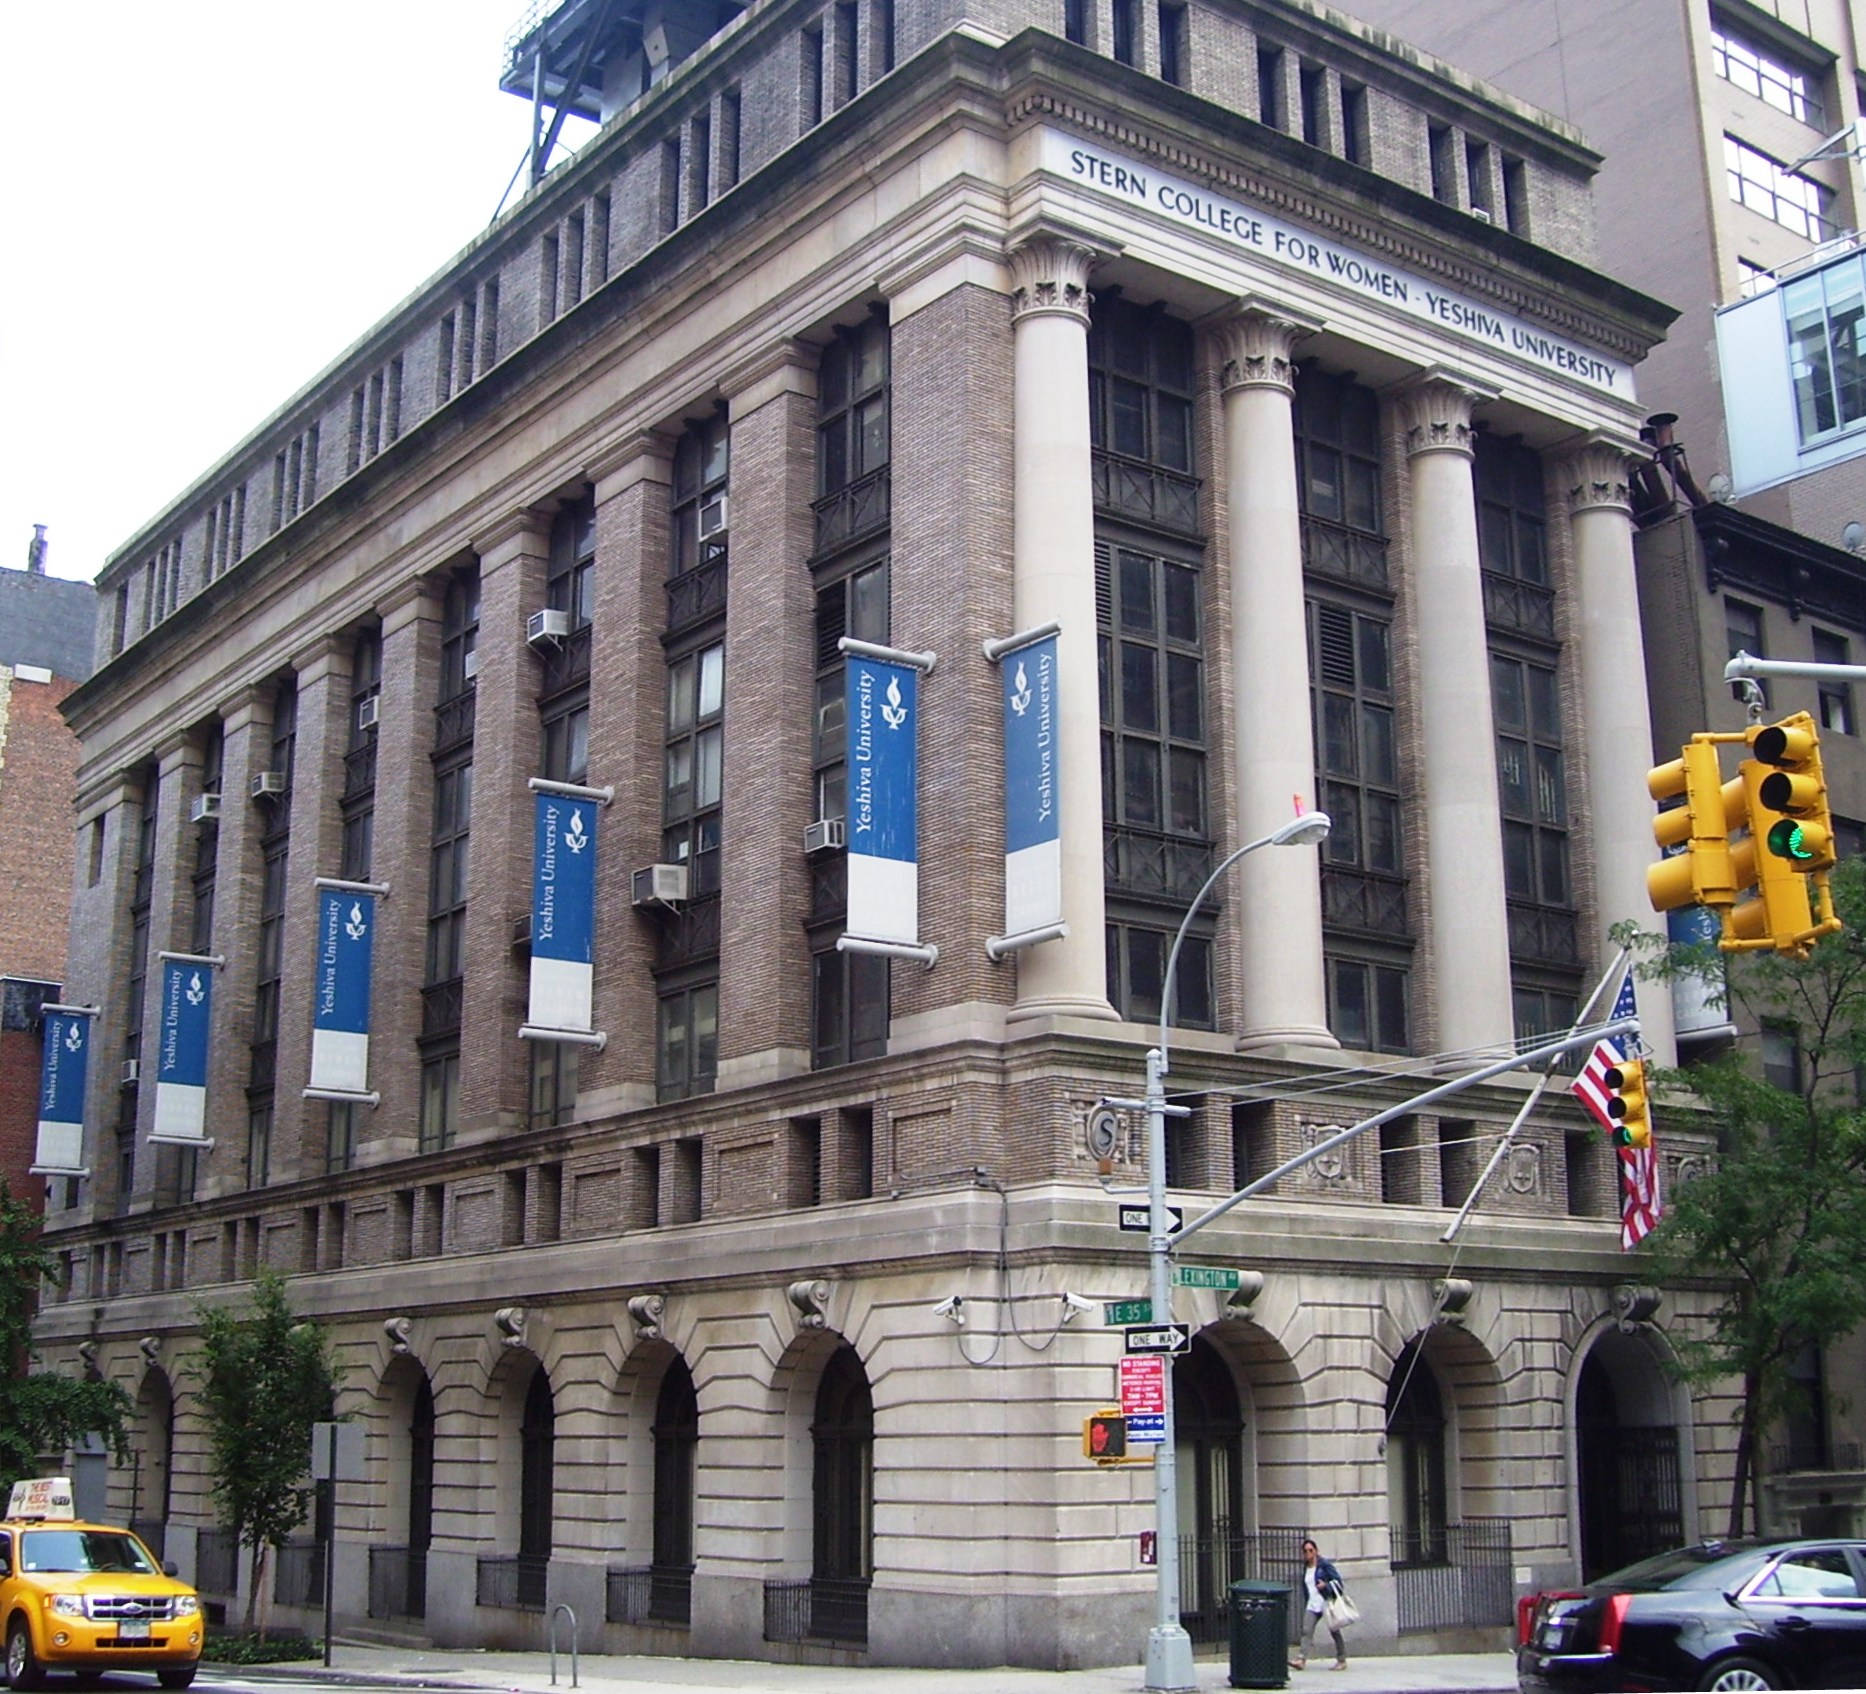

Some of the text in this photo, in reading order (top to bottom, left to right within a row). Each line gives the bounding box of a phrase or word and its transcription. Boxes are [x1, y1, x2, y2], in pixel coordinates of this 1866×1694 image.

[1071, 150, 1147, 198] STERN
[1158, 186, 1263, 245] COLLEGE
[1274, 231, 1320, 268] FOR
[1326, 251, 1408, 302] WOMEN
[1425, 292, 1505, 343] YESHIVA
[1512, 327, 1616, 387] UNIVERSITY
[856, 670, 876, 834] Yeshiva University
[1037, 652, 1053, 823] Yeshiva University
[539, 804, 560, 941] Yeshiva University
[321, 899, 342, 1016] Yeshiva University
[164, 969, 183, 1070] Yeshiva University
[1126, 1212, 1143, 1224] ONE
[1115, 1306, 1122, 1321] E
[1127, 1303, 1140, 1320] 35
[1179, 1268, 1227, 1287] LEXINGTON
[1133, 1333, 1180, 1346] ONE WAY
